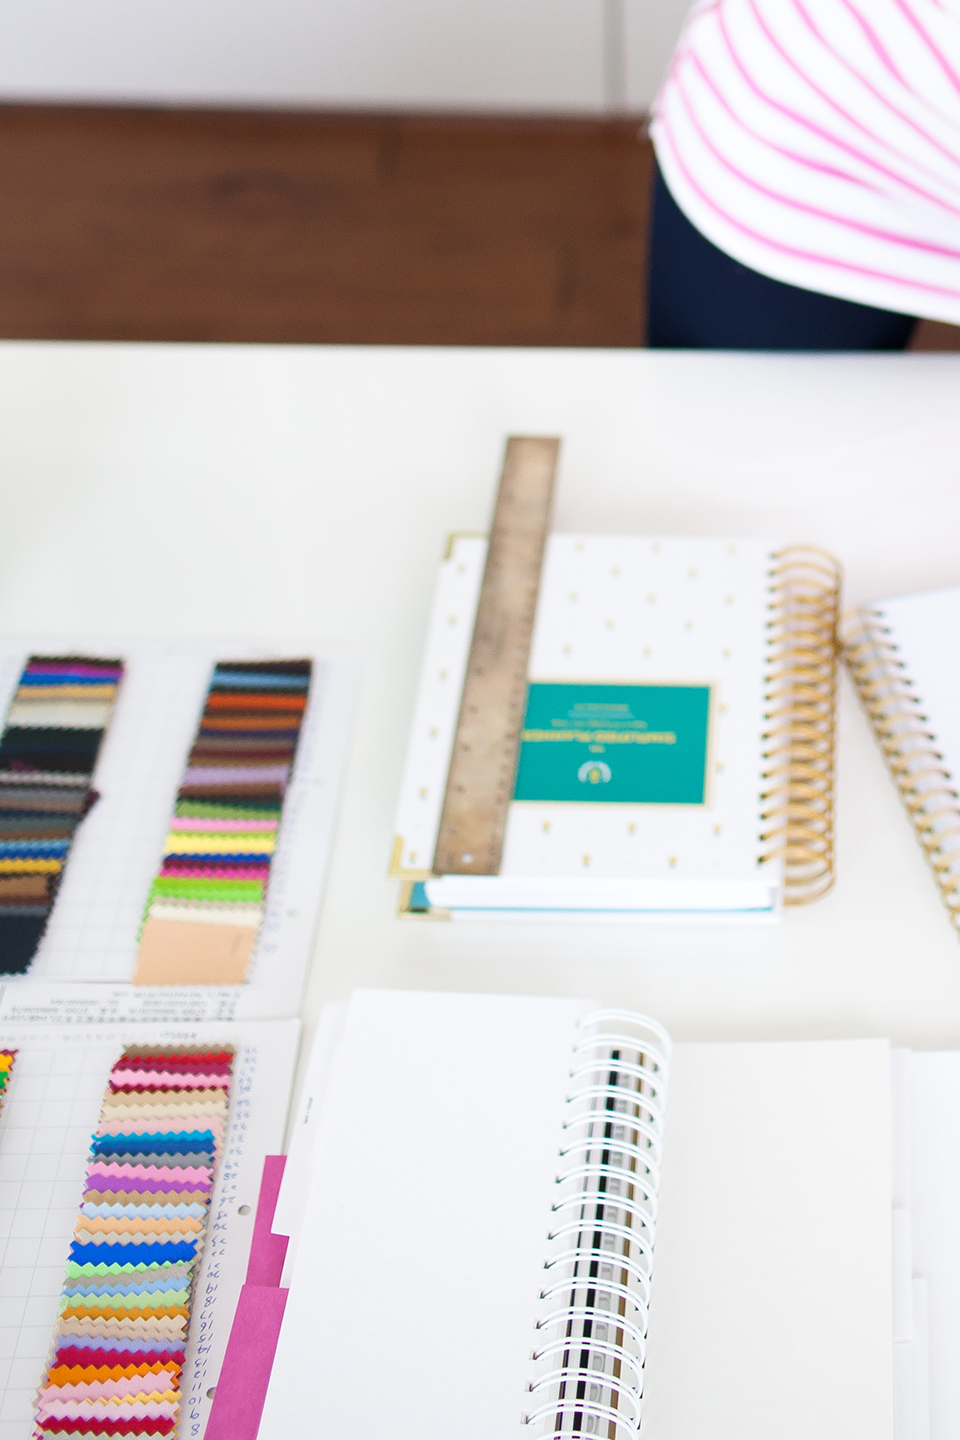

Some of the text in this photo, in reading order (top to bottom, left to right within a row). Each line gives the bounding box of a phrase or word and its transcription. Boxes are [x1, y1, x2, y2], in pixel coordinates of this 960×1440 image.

[206, 1283, 218, 1294] 19
[204, 1296, 217, 1307] 18
[200, 1311, 213, 1319] 17
[200, 1320, 213, 1332] 16
[196, 1333, 213, 1346] 15
[197, 1345, 210, 1354] 14
[195, 1358, 207, 1367] 13
[194, 1370, 206, 1378] 12
[192, 1382, 201, 1391] 11
[189, 1396, 202, 1405] 10
[190, 1408, 199, 1419] 9
[191, 1424, 200, 1436] 8
